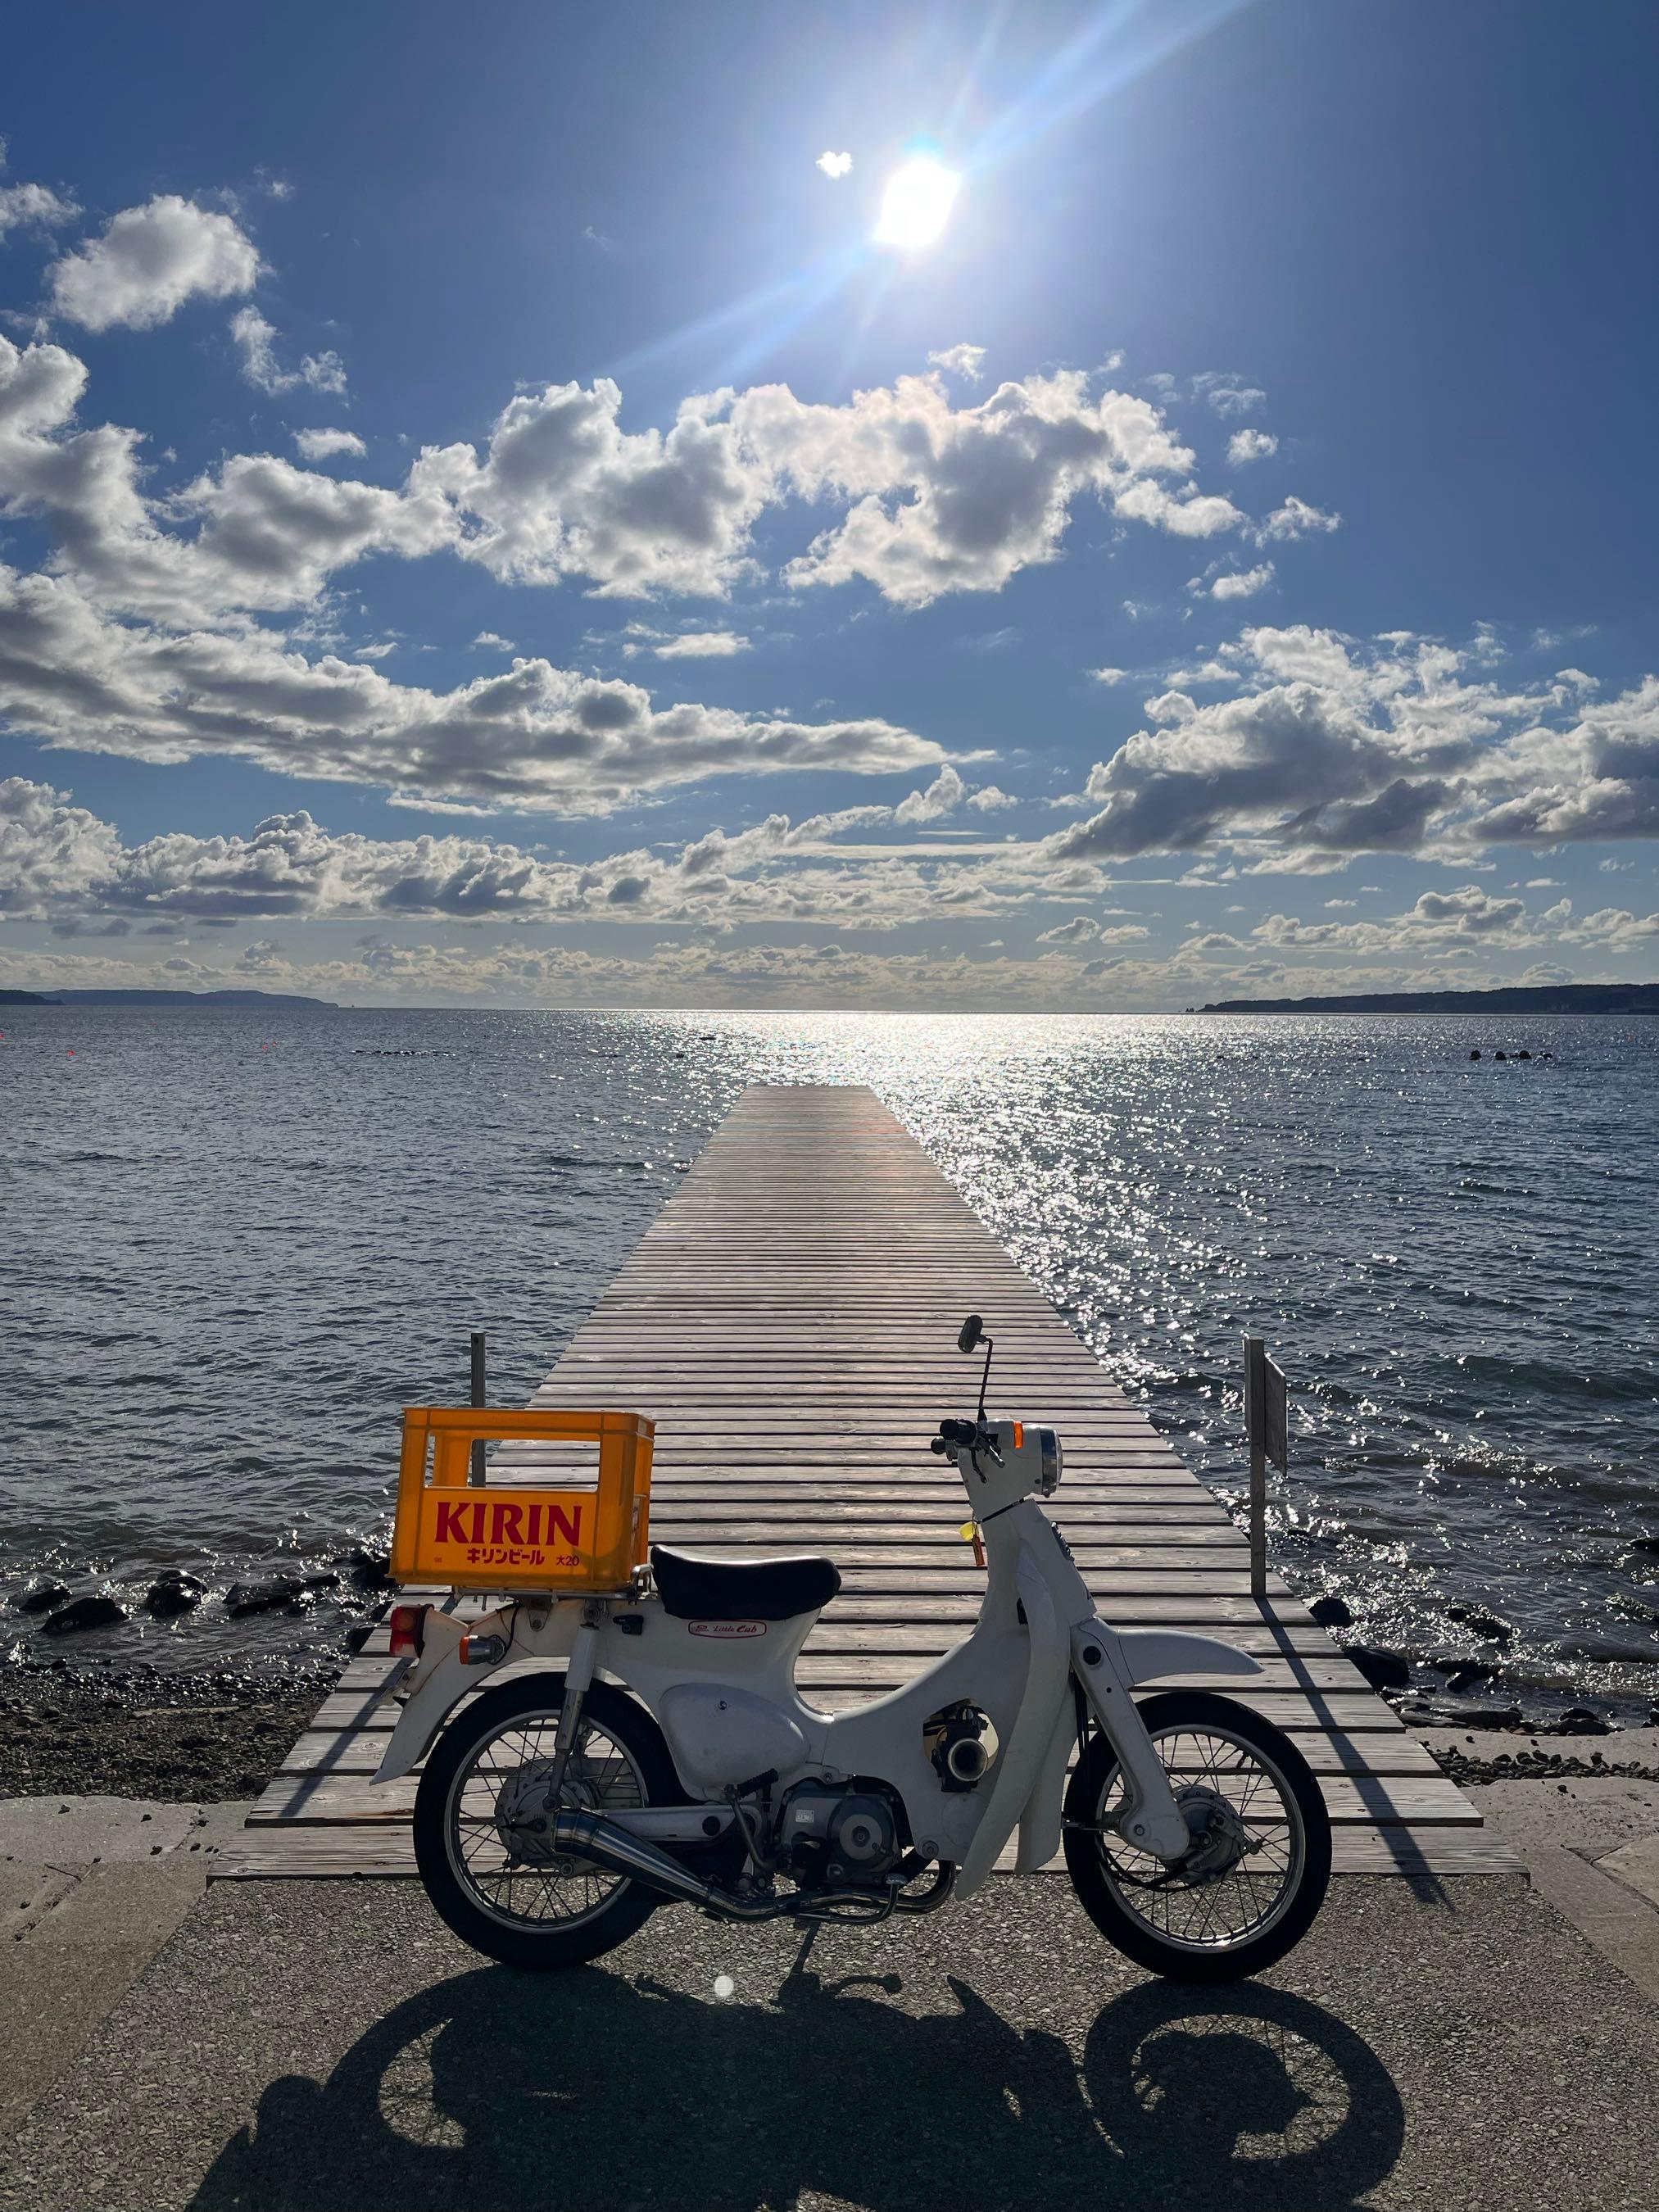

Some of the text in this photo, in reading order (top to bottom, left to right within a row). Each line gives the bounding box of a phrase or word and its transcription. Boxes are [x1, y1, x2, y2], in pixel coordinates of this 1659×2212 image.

[434, 1502, 582, 1547] KIRIN
[467, 1548, 545, 1566] キリンビール
[555, 1555, 580, 1566] 大20
[713, 1625, 735, 1633] Little
[737, 1625, 757, 1633] Cub
